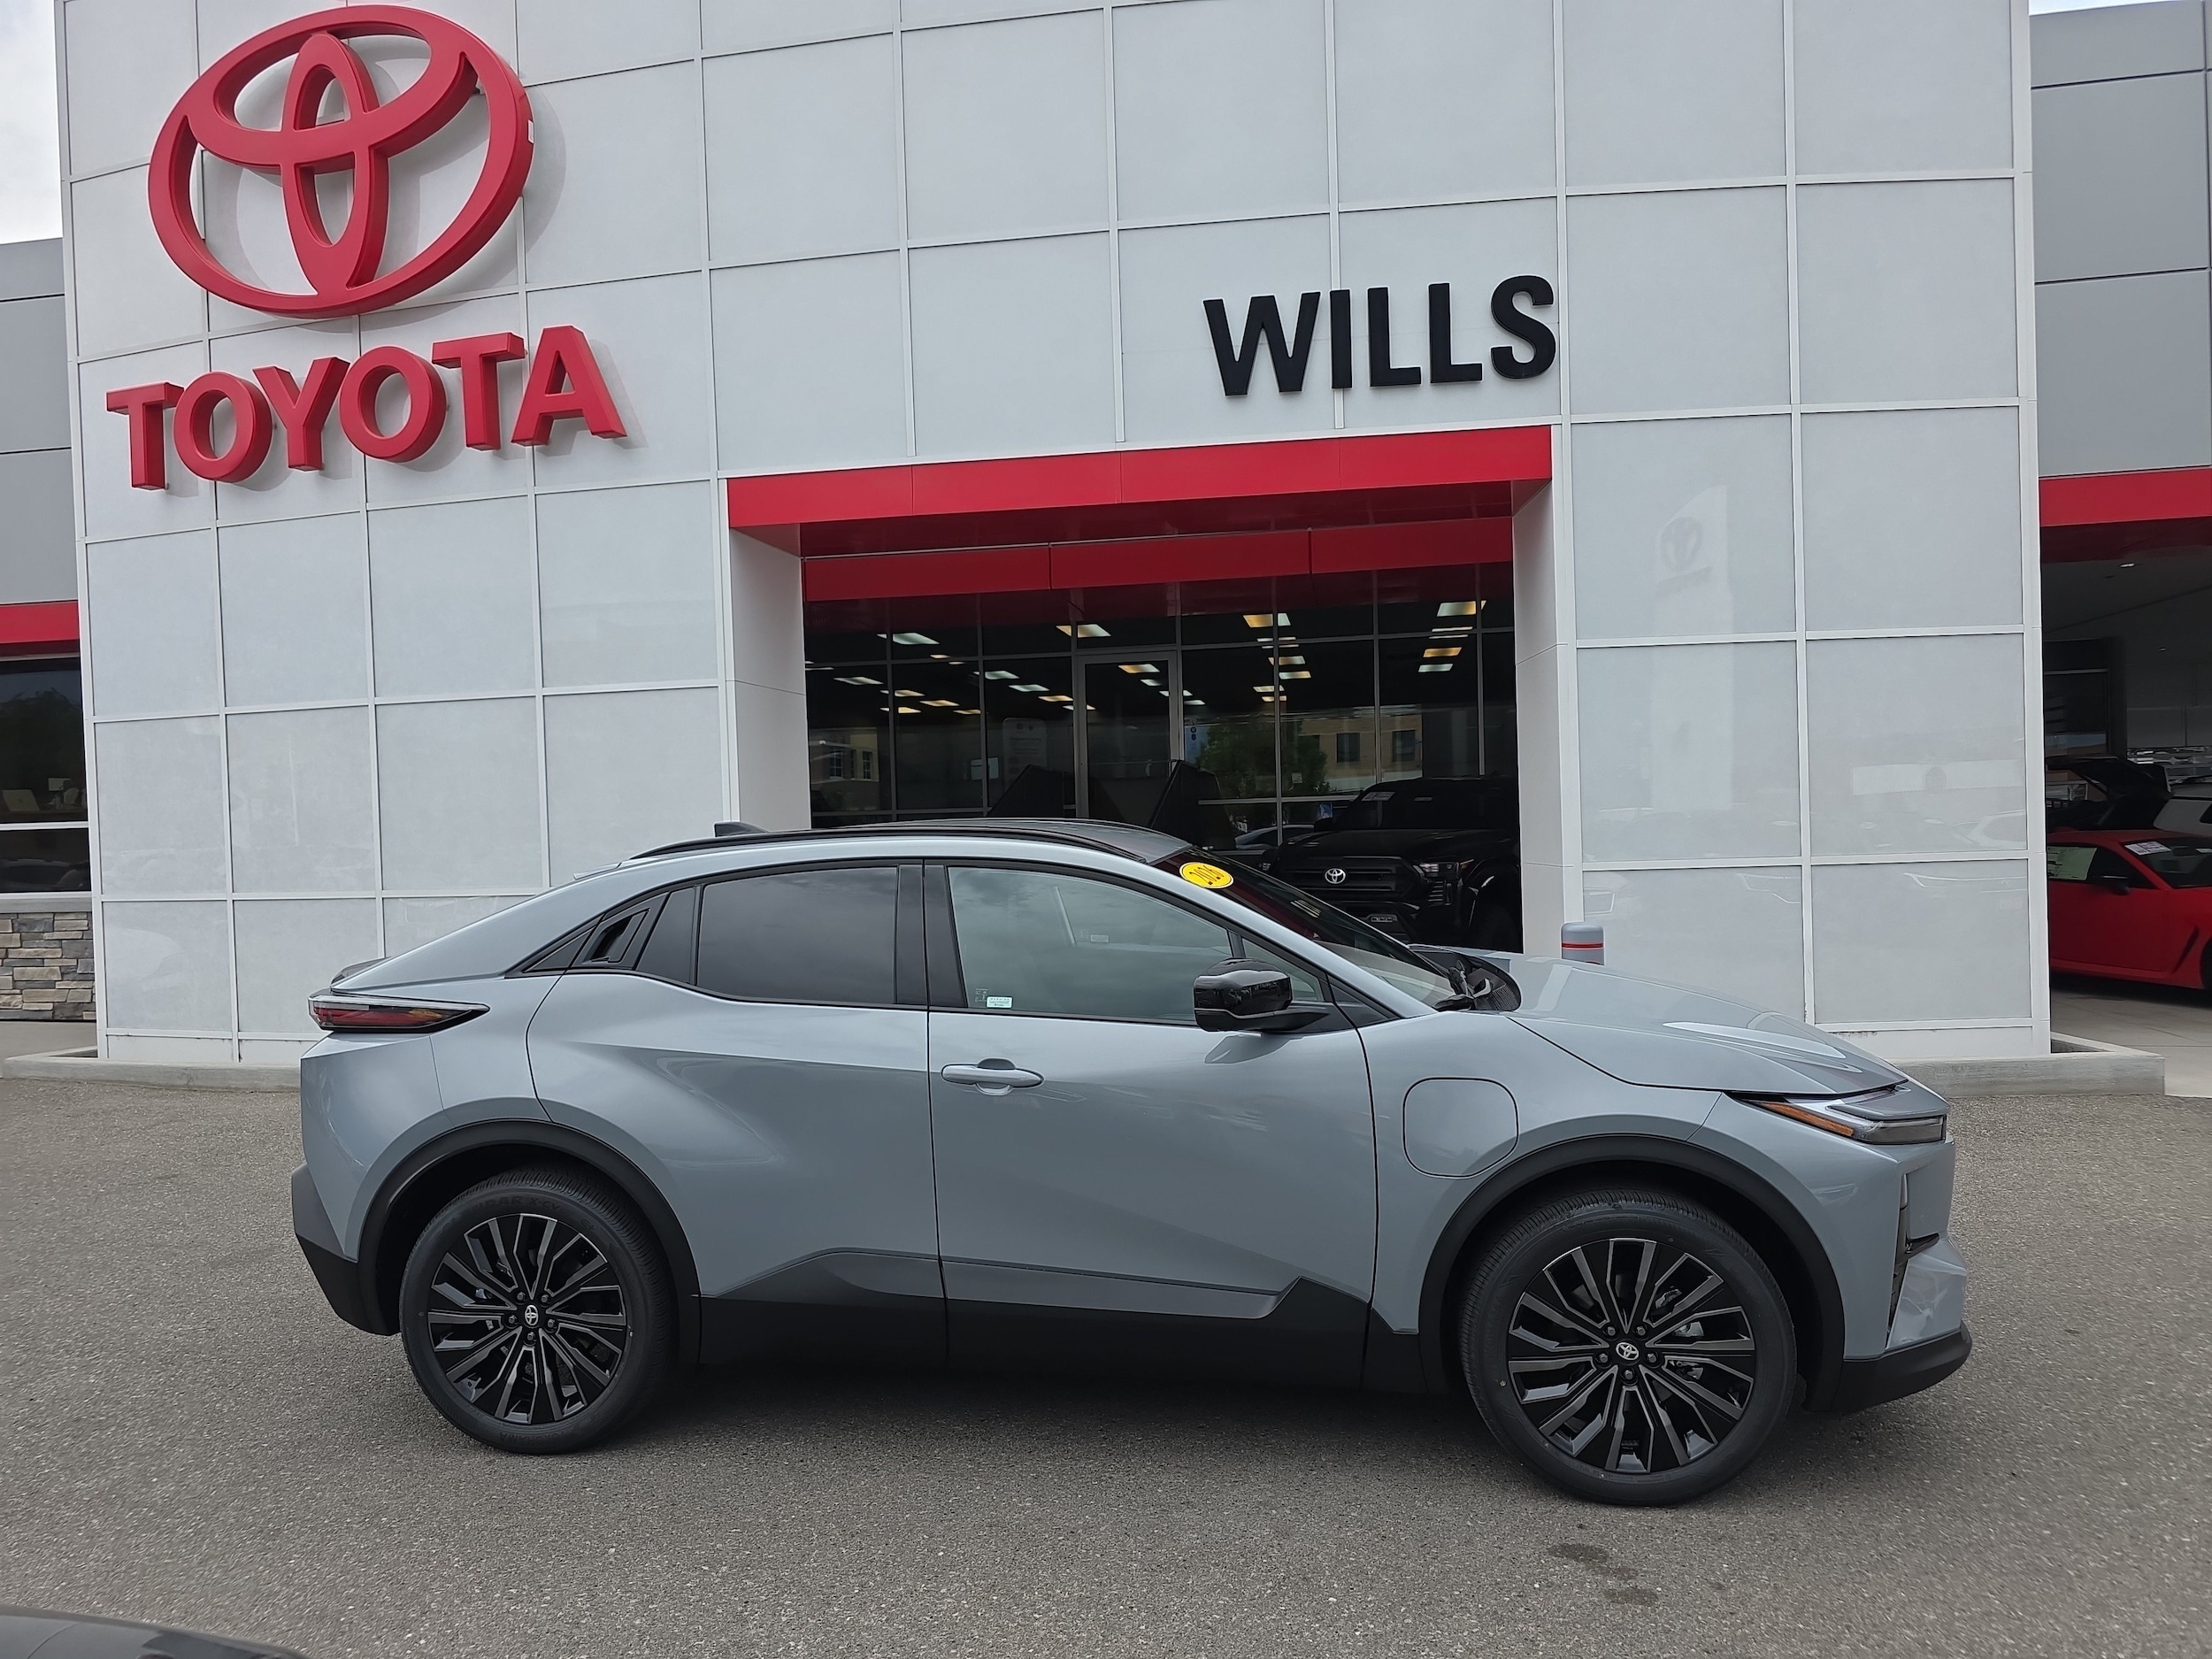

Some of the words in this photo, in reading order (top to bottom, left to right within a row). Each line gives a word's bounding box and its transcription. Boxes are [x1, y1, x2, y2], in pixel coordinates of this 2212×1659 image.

[1202, 274, 1556, 396] WILLS
[106, 325, 627, 491] TOYOTA
[1188, 864, 1225, 886] 2026
